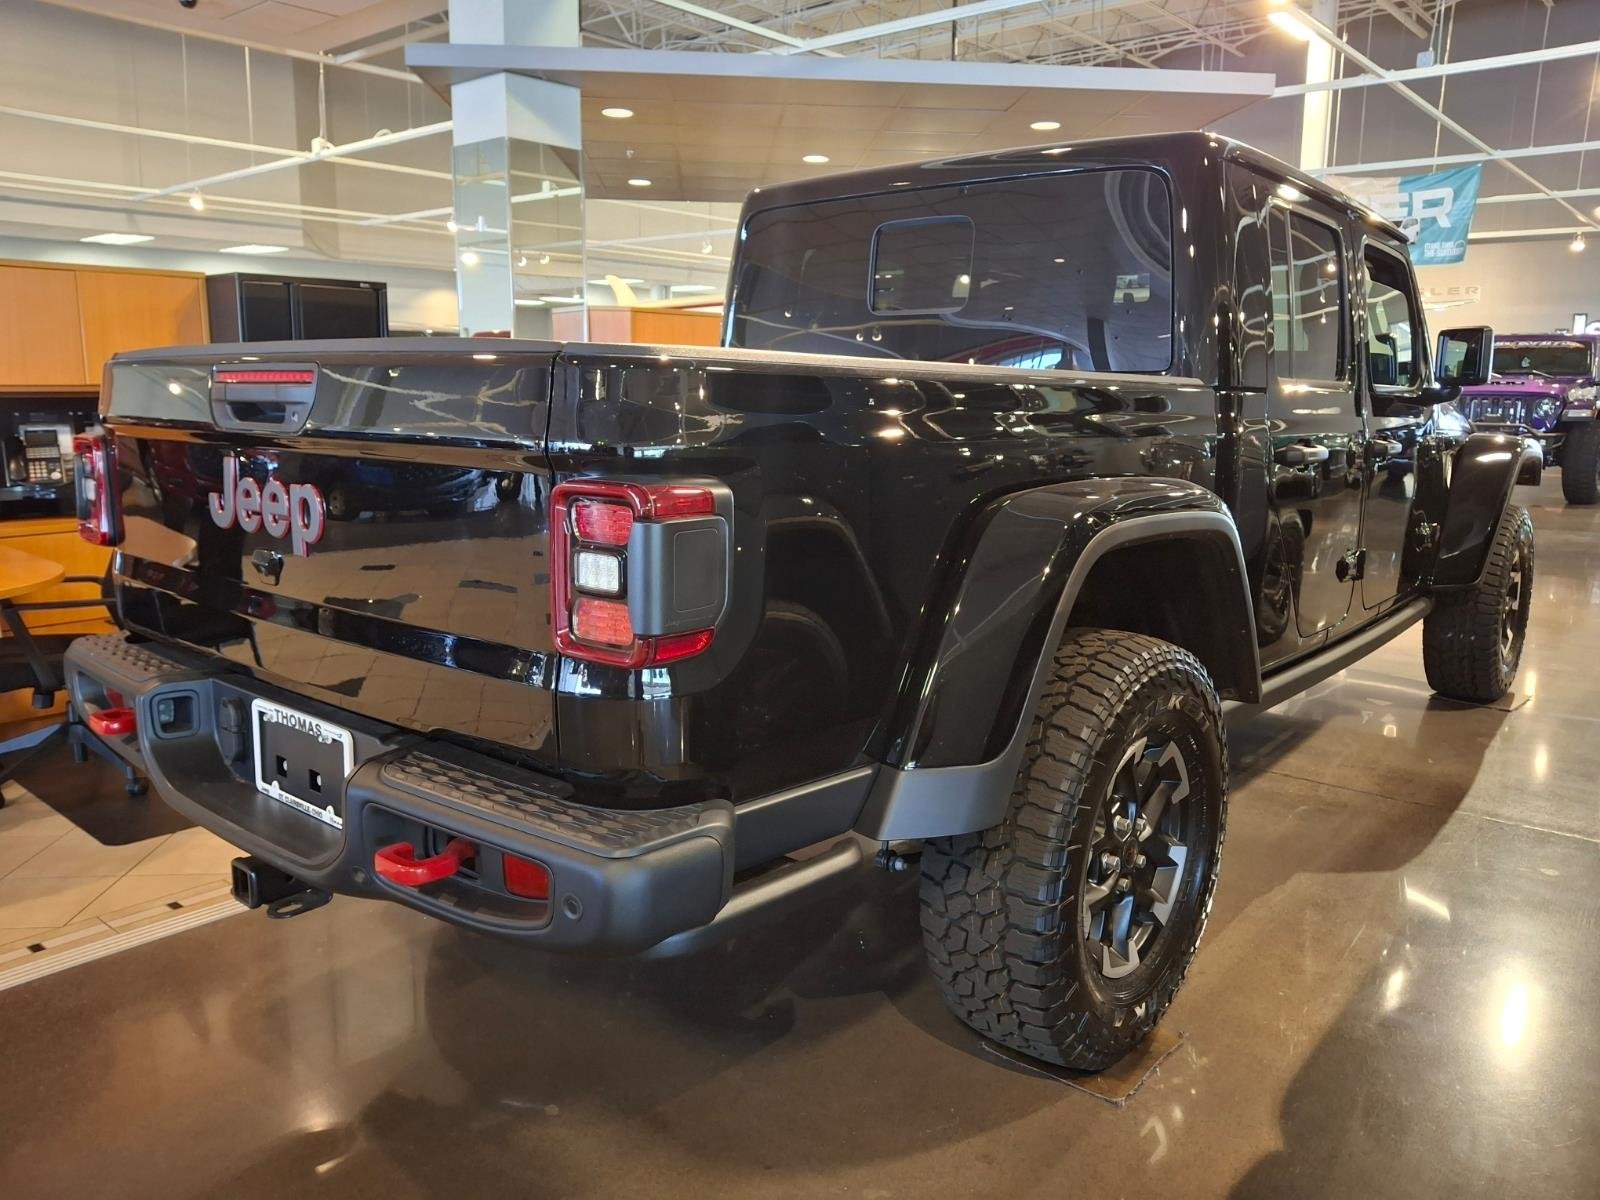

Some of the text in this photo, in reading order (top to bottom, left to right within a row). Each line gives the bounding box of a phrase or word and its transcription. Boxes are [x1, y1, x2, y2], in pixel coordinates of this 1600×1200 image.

[1368, 187, 1455, 228] ER
[208, 456, 326, 558] Jeep
[273, 708, 322, 737] THOMAS
